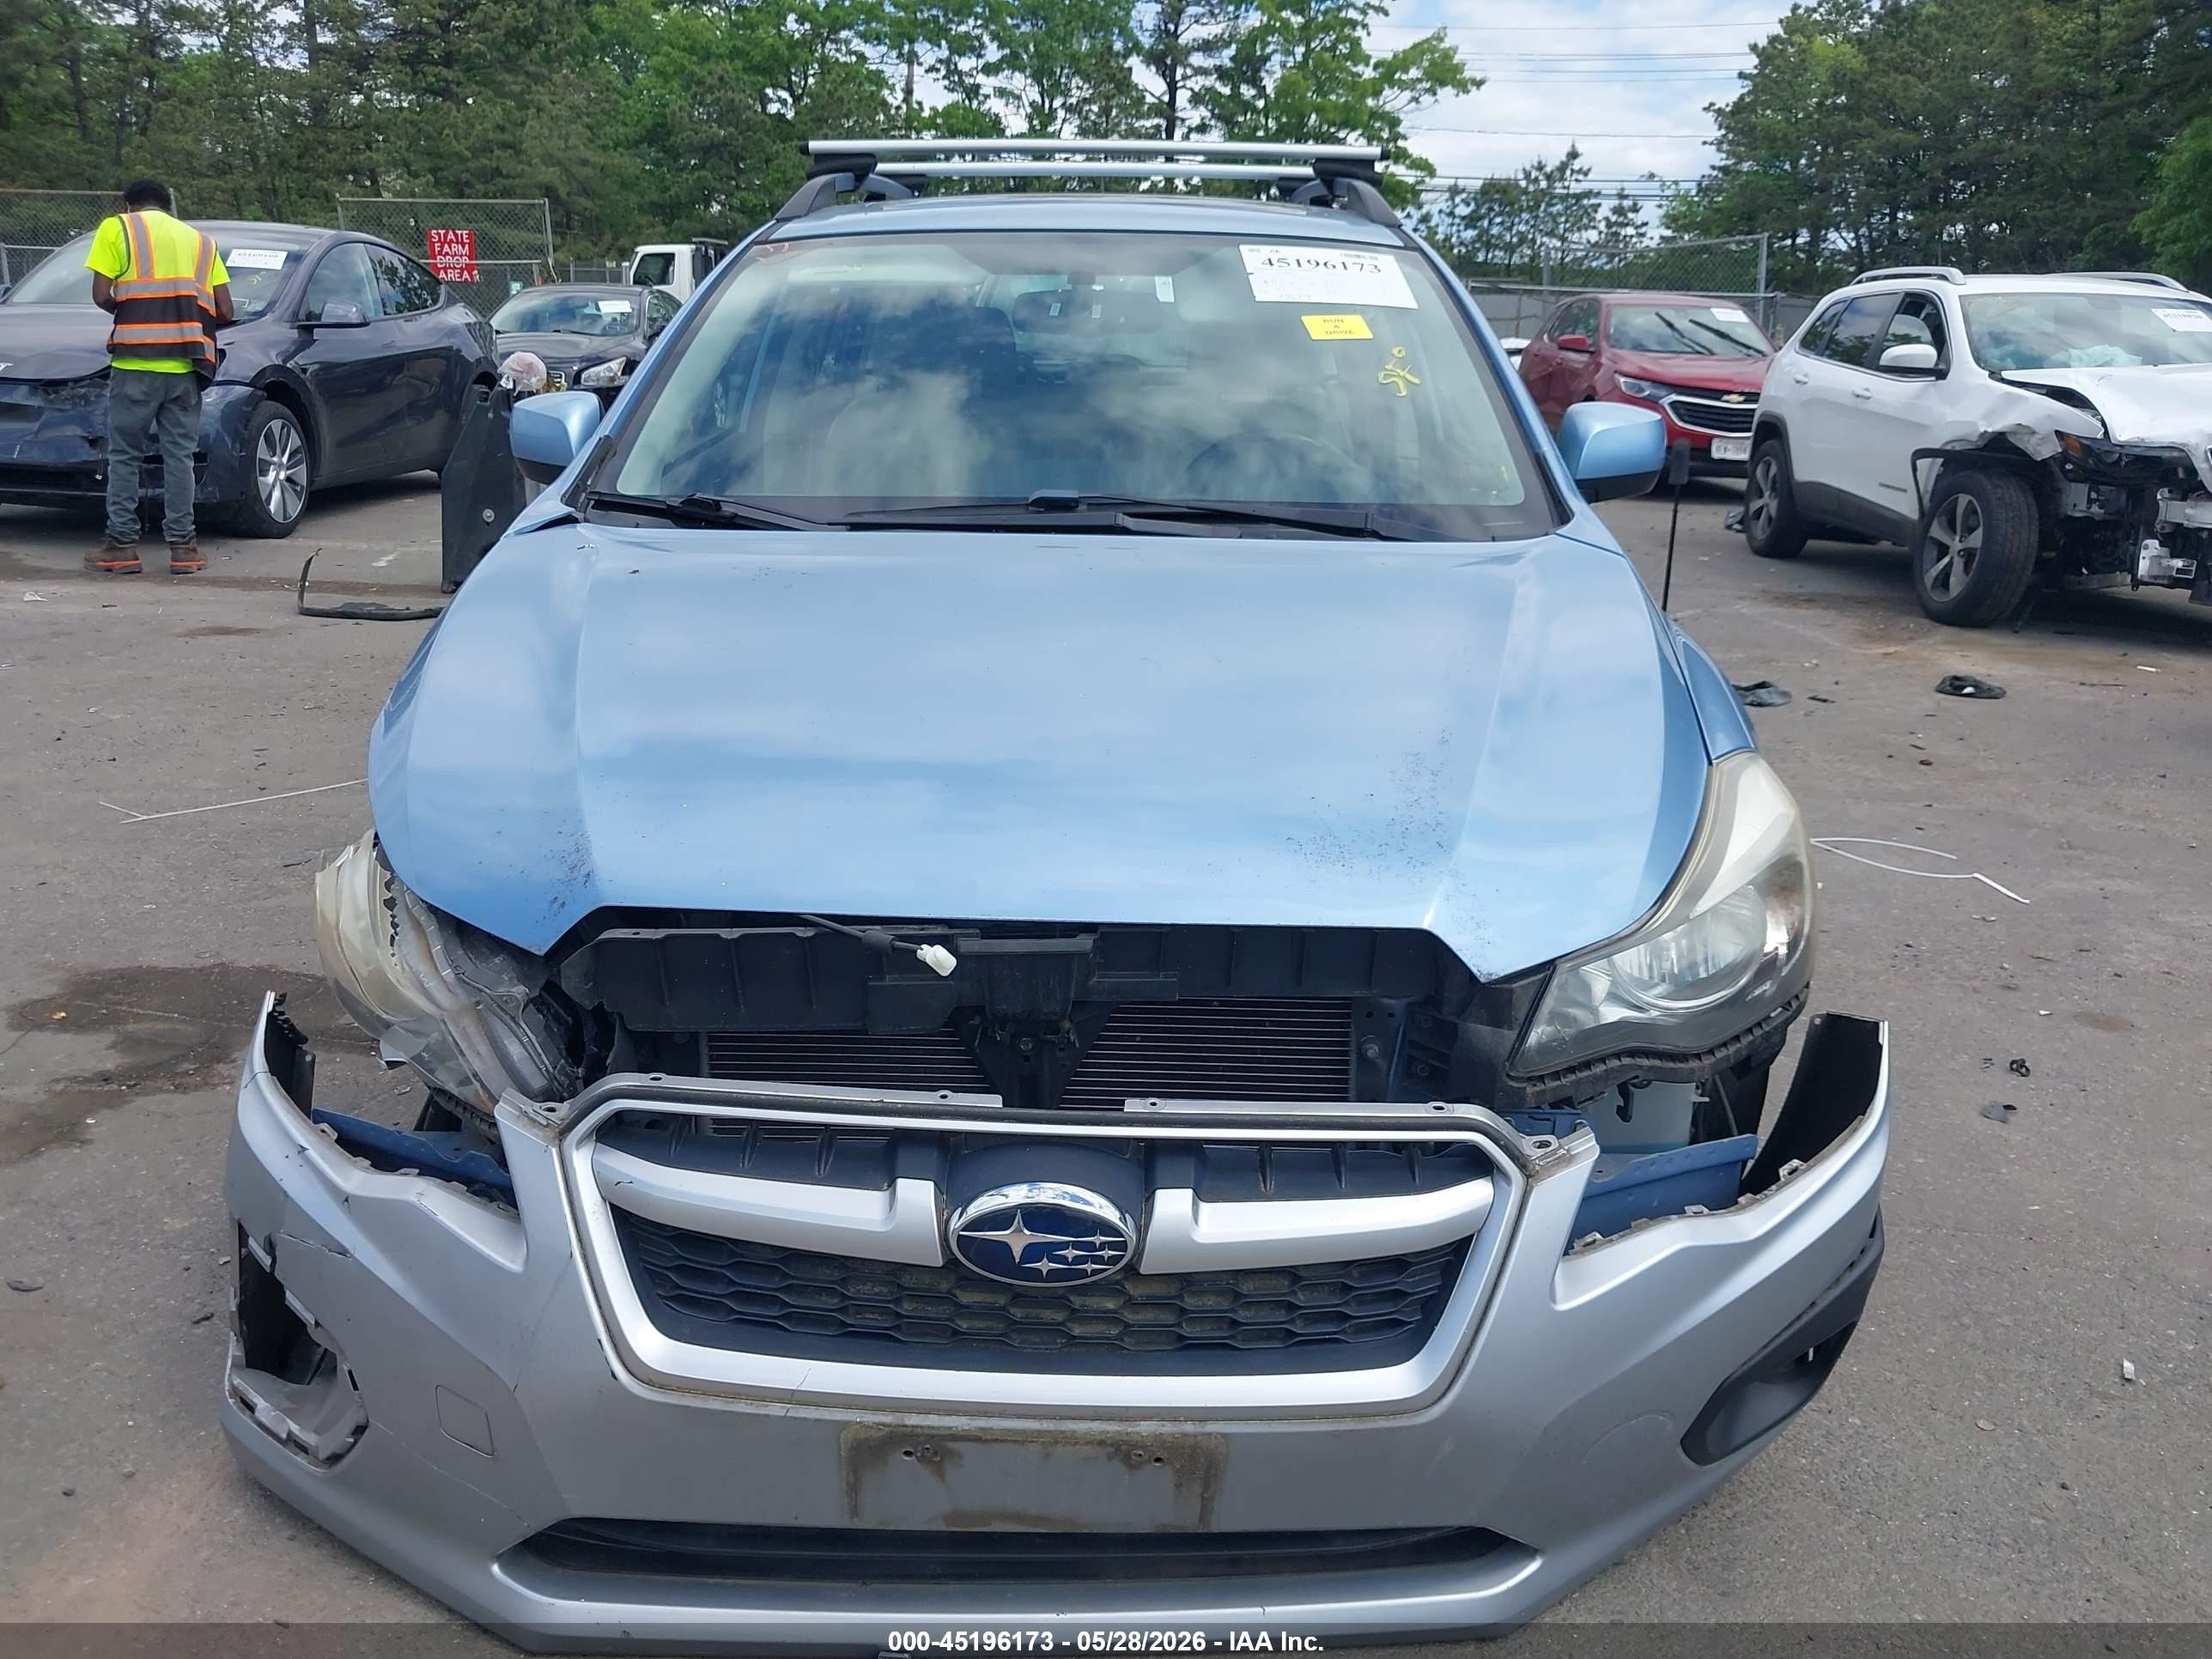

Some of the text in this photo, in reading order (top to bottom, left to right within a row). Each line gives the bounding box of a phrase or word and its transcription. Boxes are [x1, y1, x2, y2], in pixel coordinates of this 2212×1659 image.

[431, 229, 470, 243] STATE
[434, 243, 470, 256] FARM
[437, 256, 469, 268] DROP
[1261, 257, 1382, 274] 45196173
[439, 269, 471, 282] AREA
